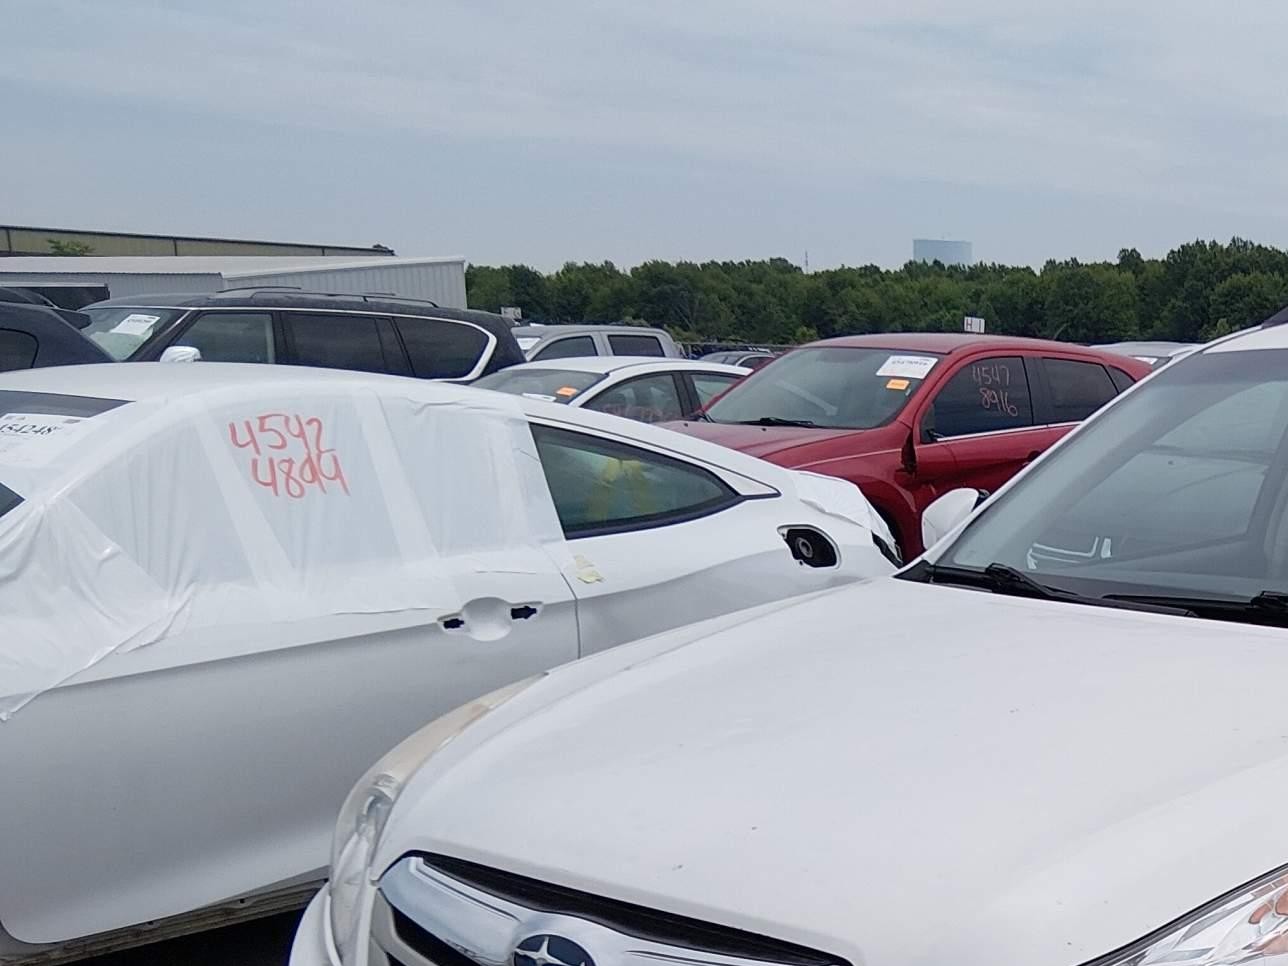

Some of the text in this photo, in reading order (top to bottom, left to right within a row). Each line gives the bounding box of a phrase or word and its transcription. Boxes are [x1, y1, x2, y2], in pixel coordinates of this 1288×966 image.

[972, 362, 1010, 387] 4547
[979, 387, 1019, 417] 8916
[228, 412, 336, 457] 4542
[251, 453, 351, 499] 4894
